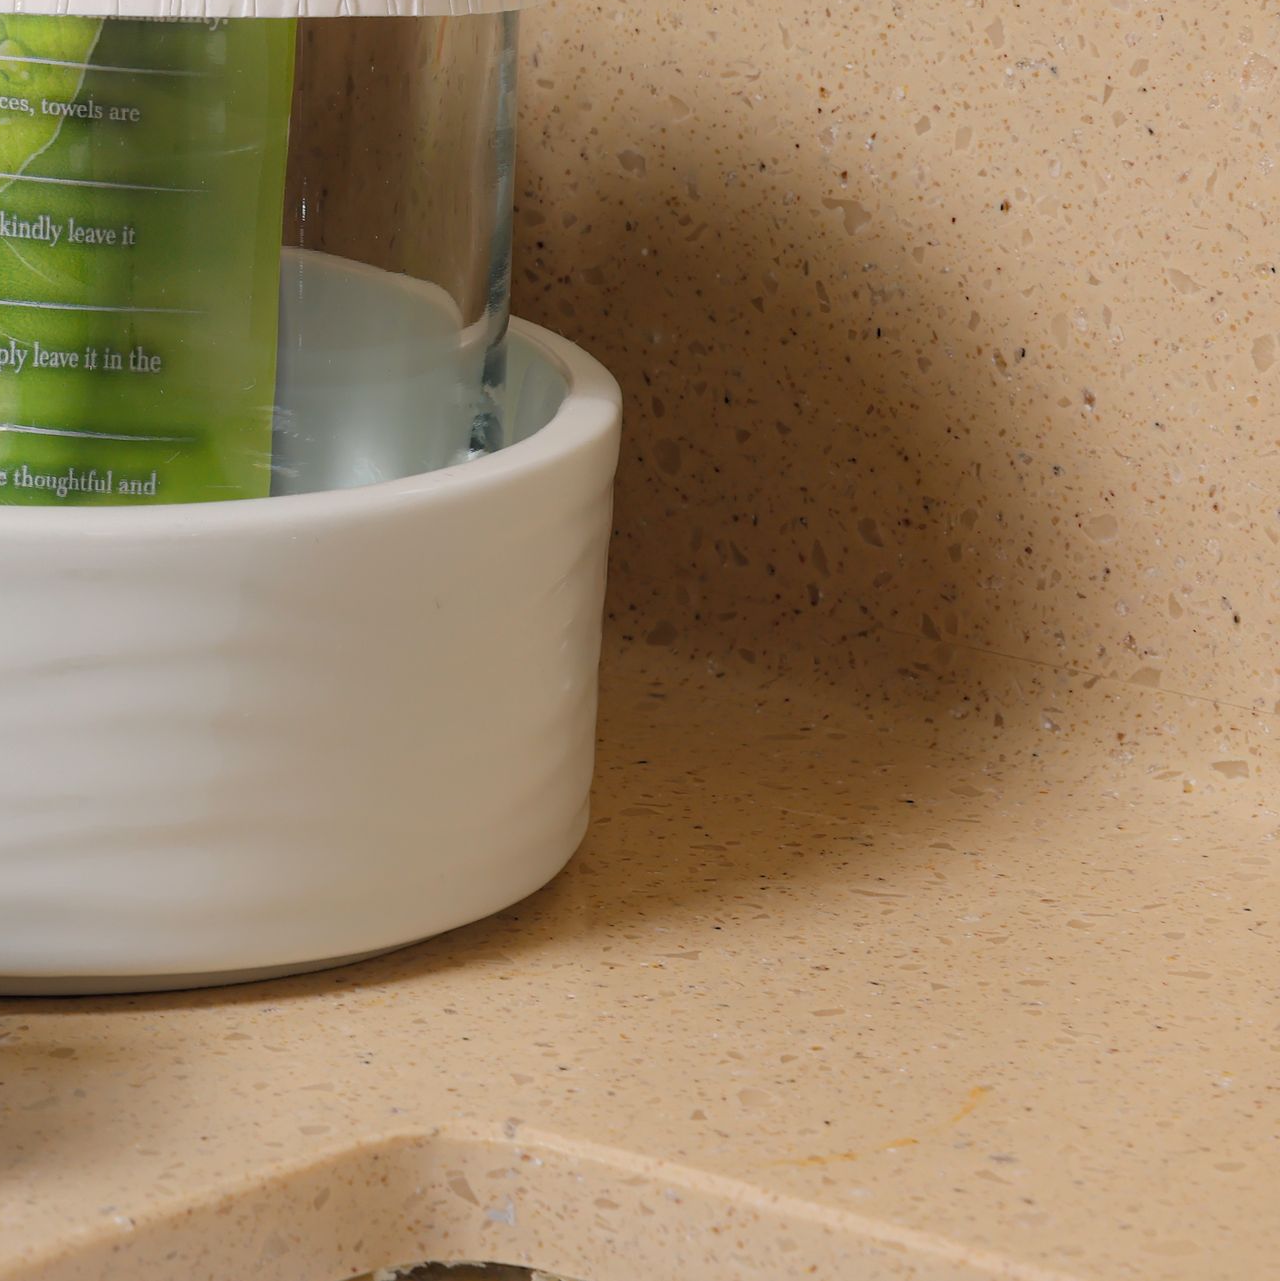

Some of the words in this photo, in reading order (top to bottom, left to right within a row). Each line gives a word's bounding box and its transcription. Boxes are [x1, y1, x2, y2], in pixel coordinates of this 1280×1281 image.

[41, 98, 104, 120] towels
[109, 106, 141, 122] are
[0, 211, 63, 247] kindly
[68, 218, 116, 245] leave
[121, 220, 136, 245] it
[33, 342, 79, 369] leave
[85, 346, 97, 370] it
[103, 347, 123, 371] in
[129, 346, 161, 373] the
[13, 464, 113, 497] thoughtful
[119, 471, 157, 496] and
